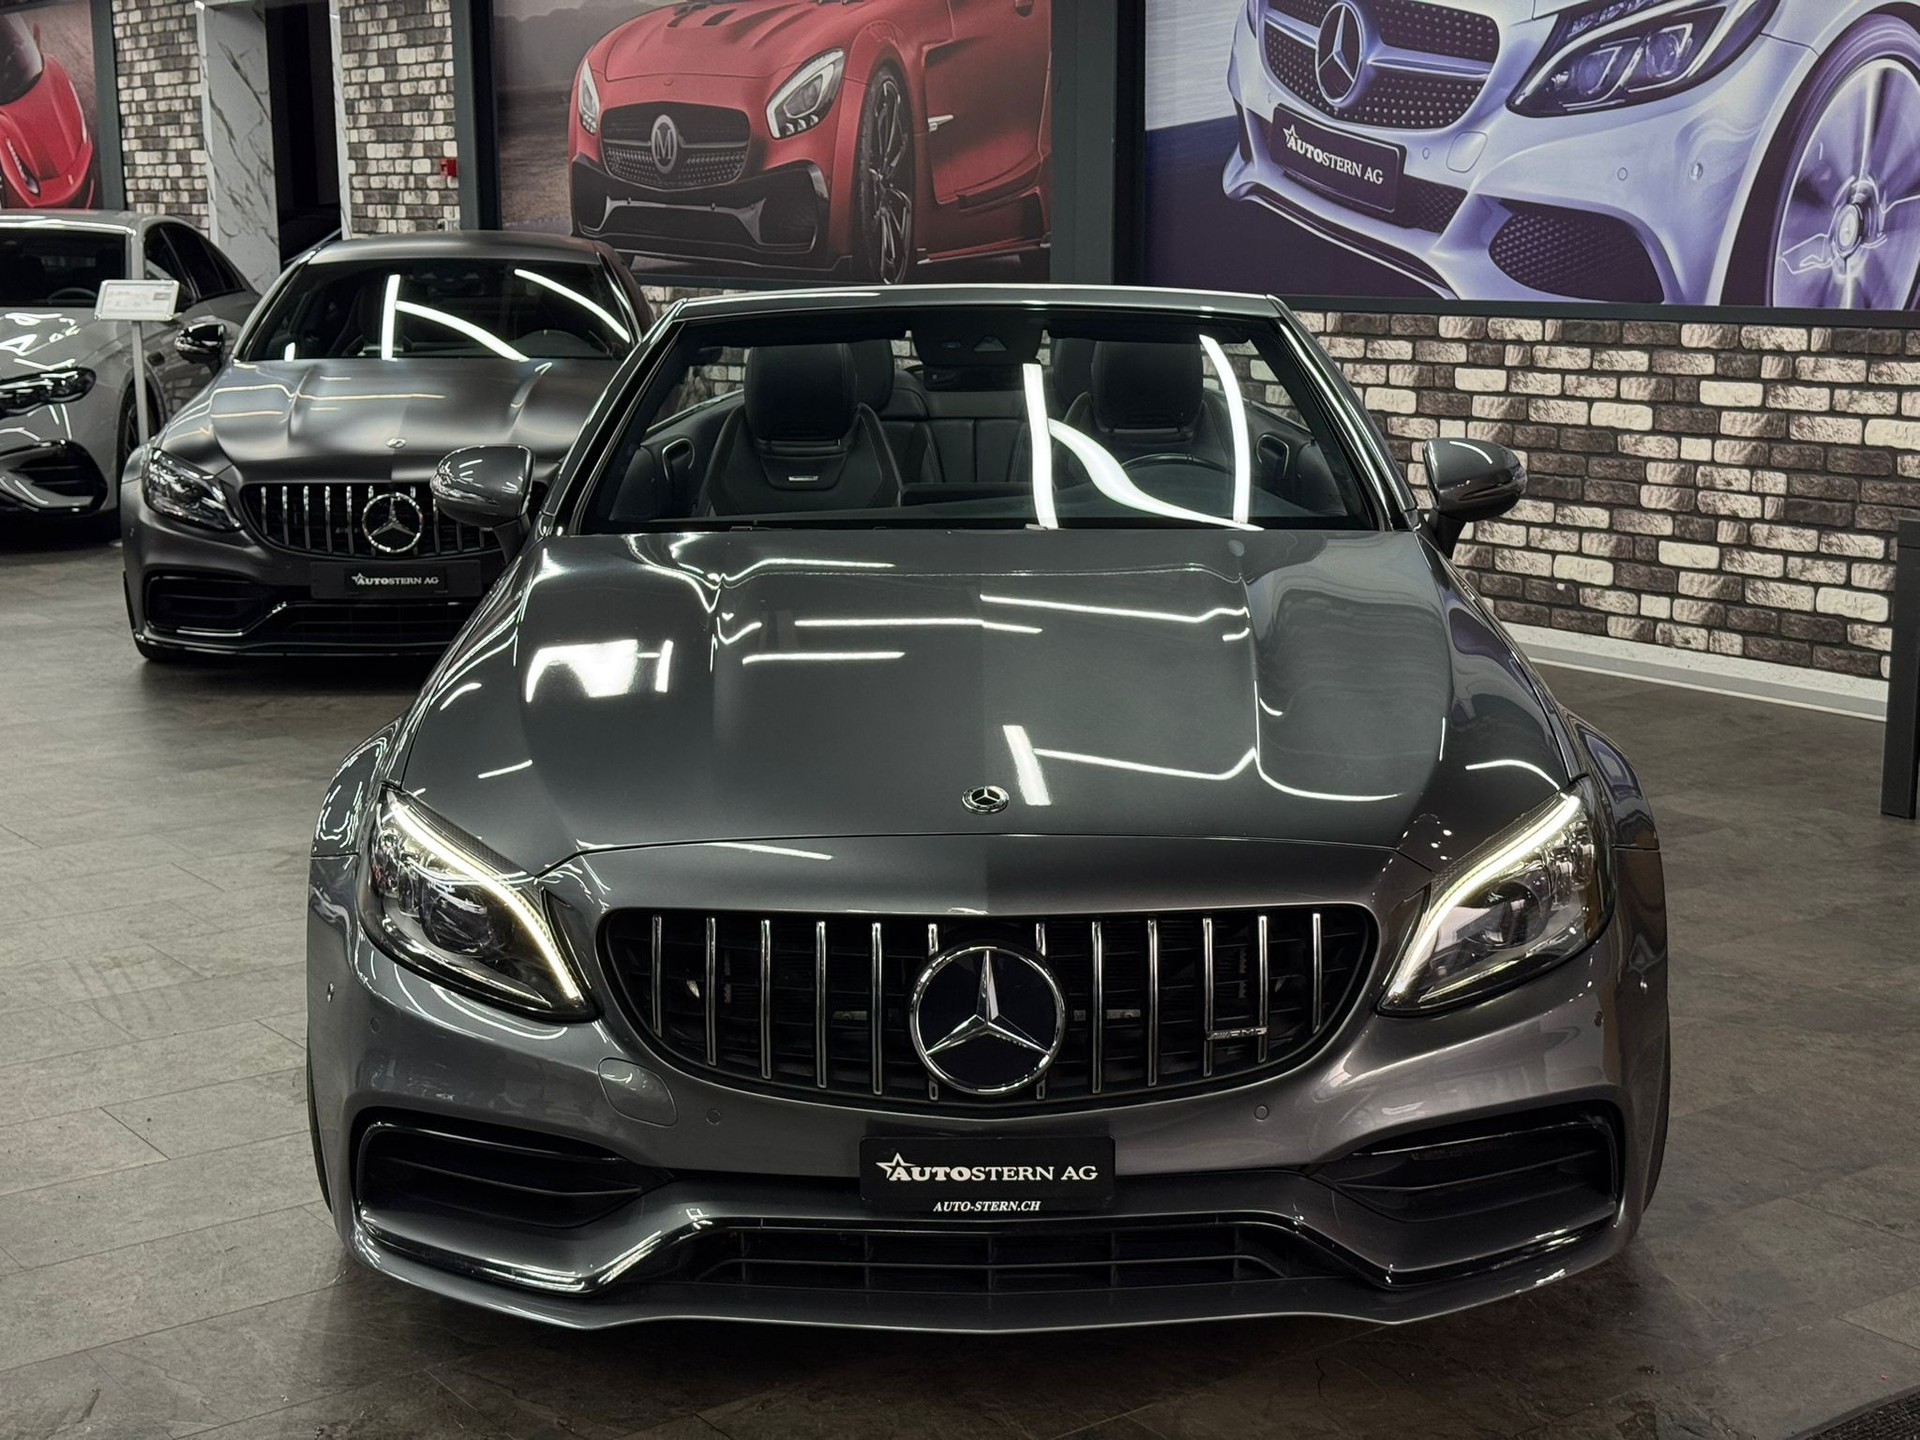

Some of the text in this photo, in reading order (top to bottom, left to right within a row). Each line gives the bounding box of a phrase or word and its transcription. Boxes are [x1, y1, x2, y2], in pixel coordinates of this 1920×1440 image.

[1287, 135, 1384, 185] AUTOSTERN AG
[357, 576, 439, 586] AUTOSTERN AG
[889, 1165, 1099, 1182] AUTOSTERN AG
[933, 1200, 1042, 1213] AUTO-STERN.CH
